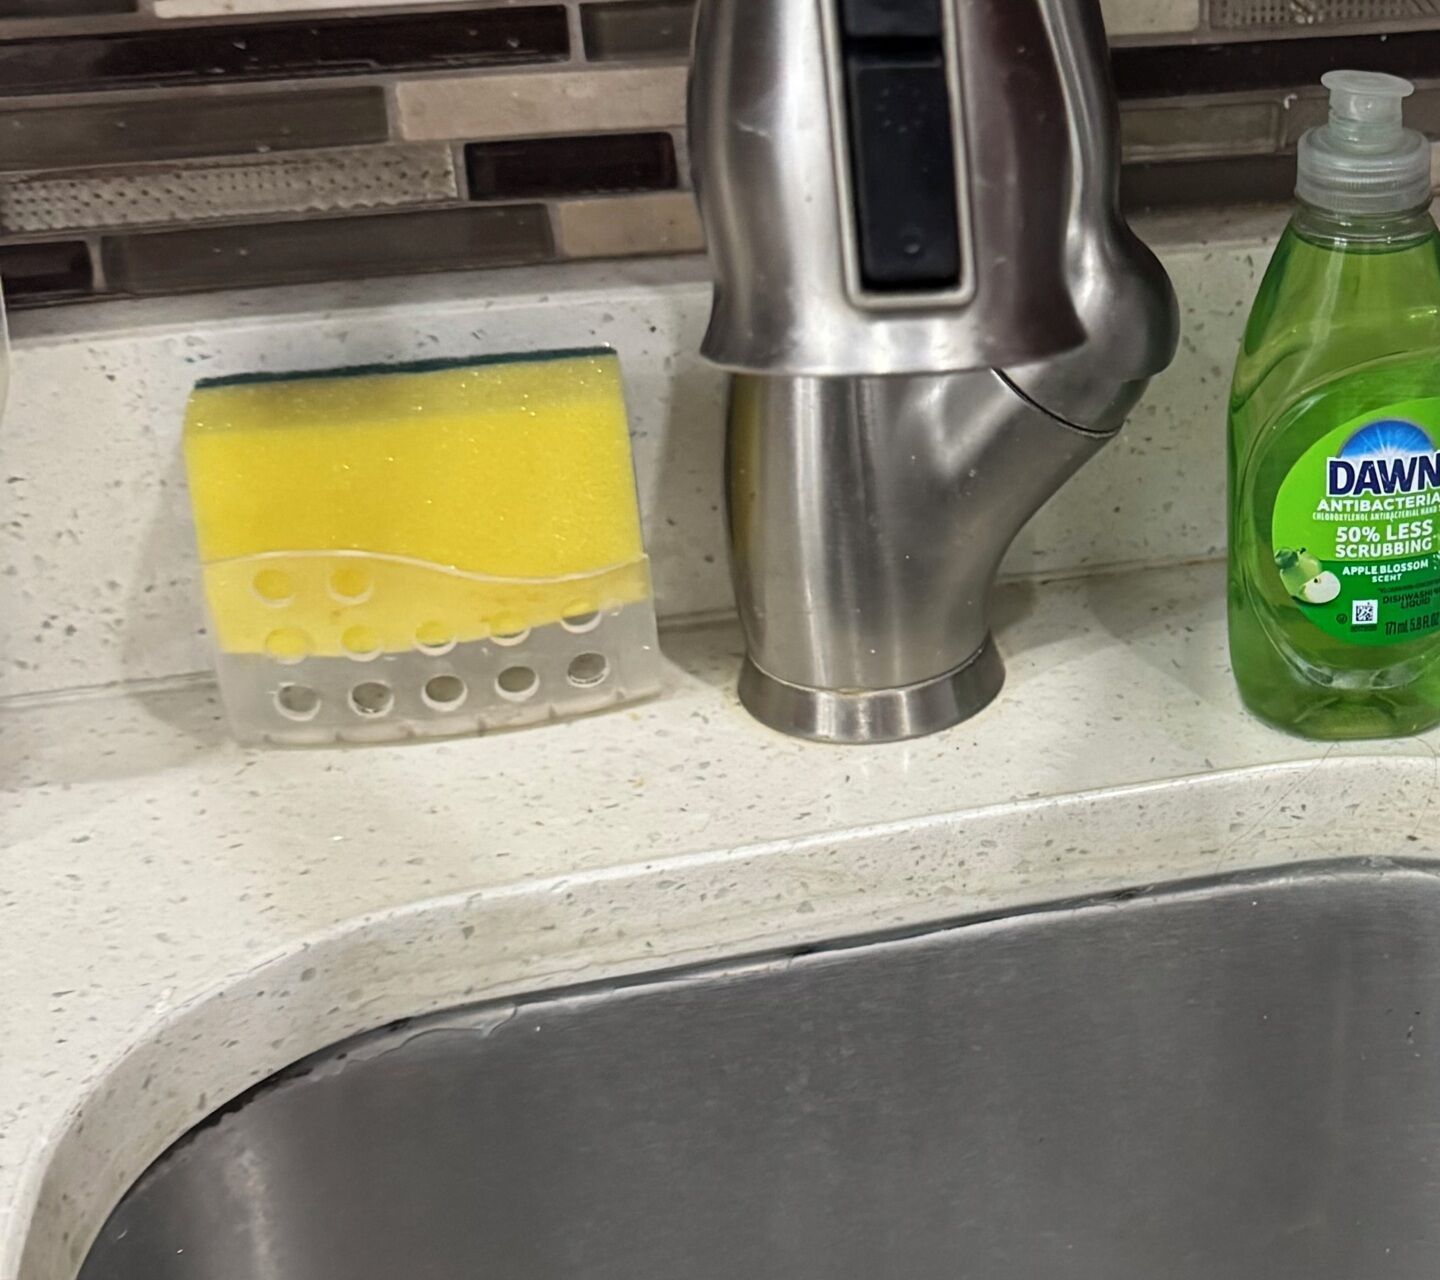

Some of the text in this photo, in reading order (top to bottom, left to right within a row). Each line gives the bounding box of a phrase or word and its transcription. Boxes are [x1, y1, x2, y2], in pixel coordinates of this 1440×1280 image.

[1336, 520, 1433, 543] 50% LESS
[1335, 537, 1433, 558] SCRUBBING
[1342, 559, 1429, 576] APPLE BLOSSOM
[1372, 573, 1402, 583] SCENT
[1401, 597, 1431, 609] LIQUID
